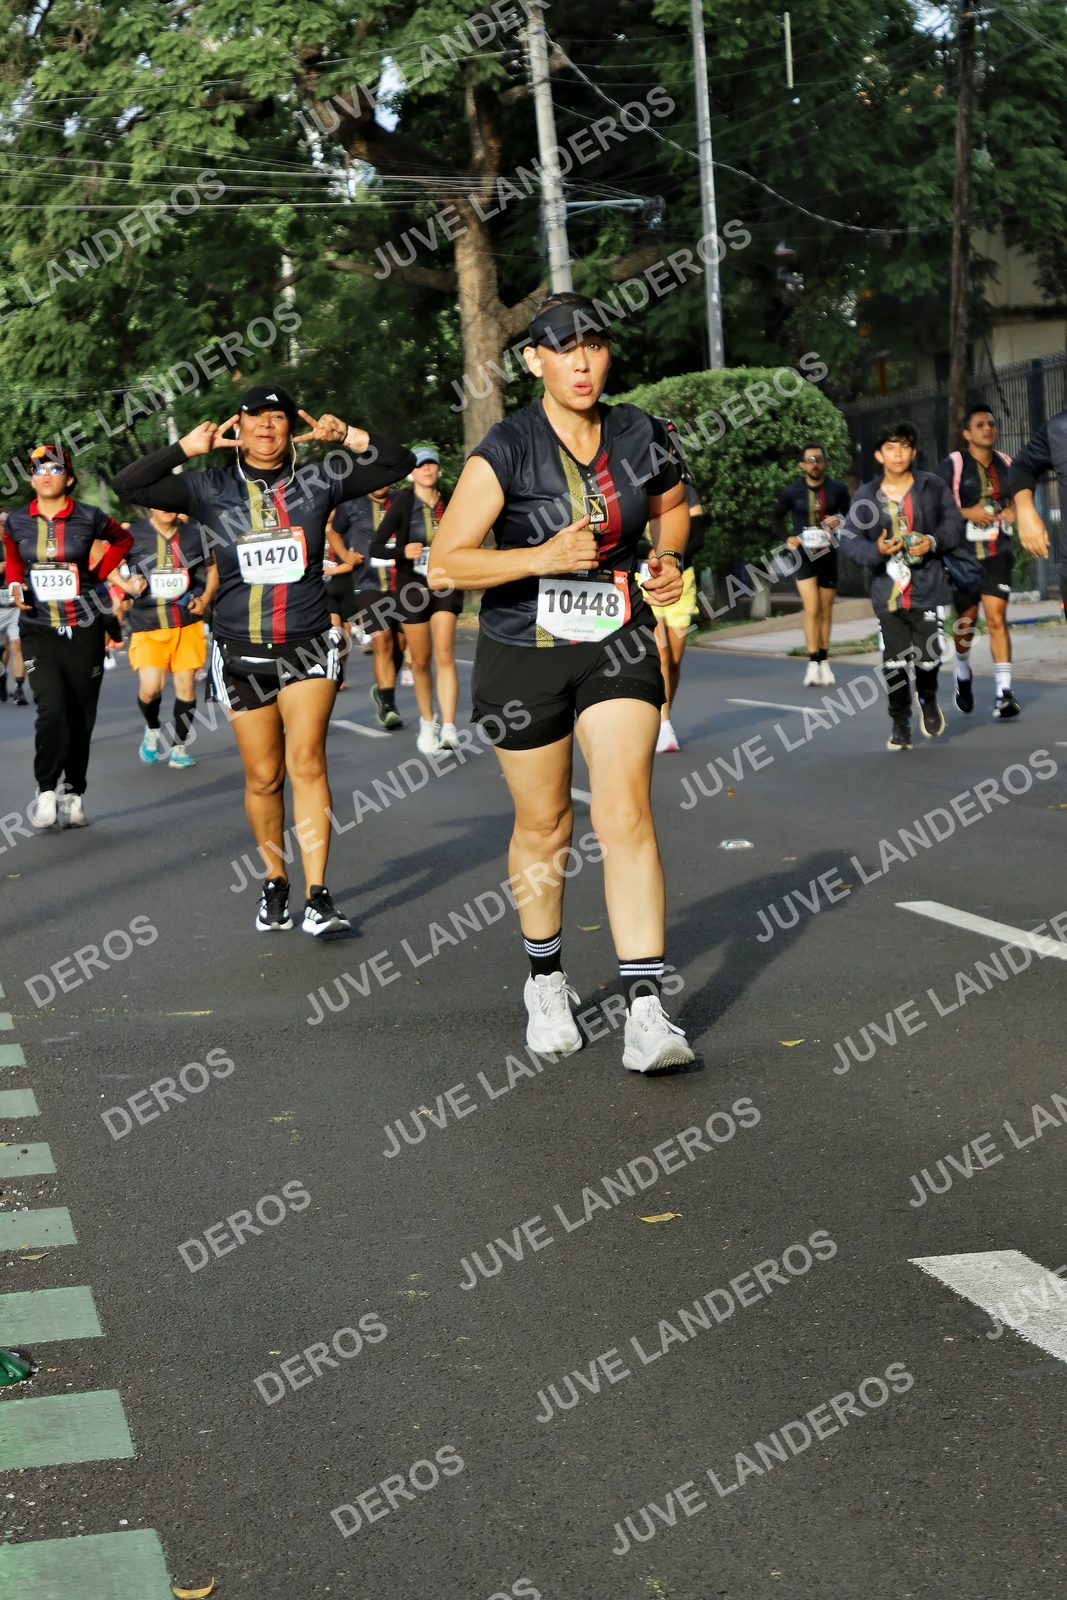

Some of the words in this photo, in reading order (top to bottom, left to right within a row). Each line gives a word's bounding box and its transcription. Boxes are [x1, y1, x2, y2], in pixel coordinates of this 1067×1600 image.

[243, 545, 298, 567] 11470
[34, 574, 73, 587] 12336
[544, 588, 620, 617] 10448
